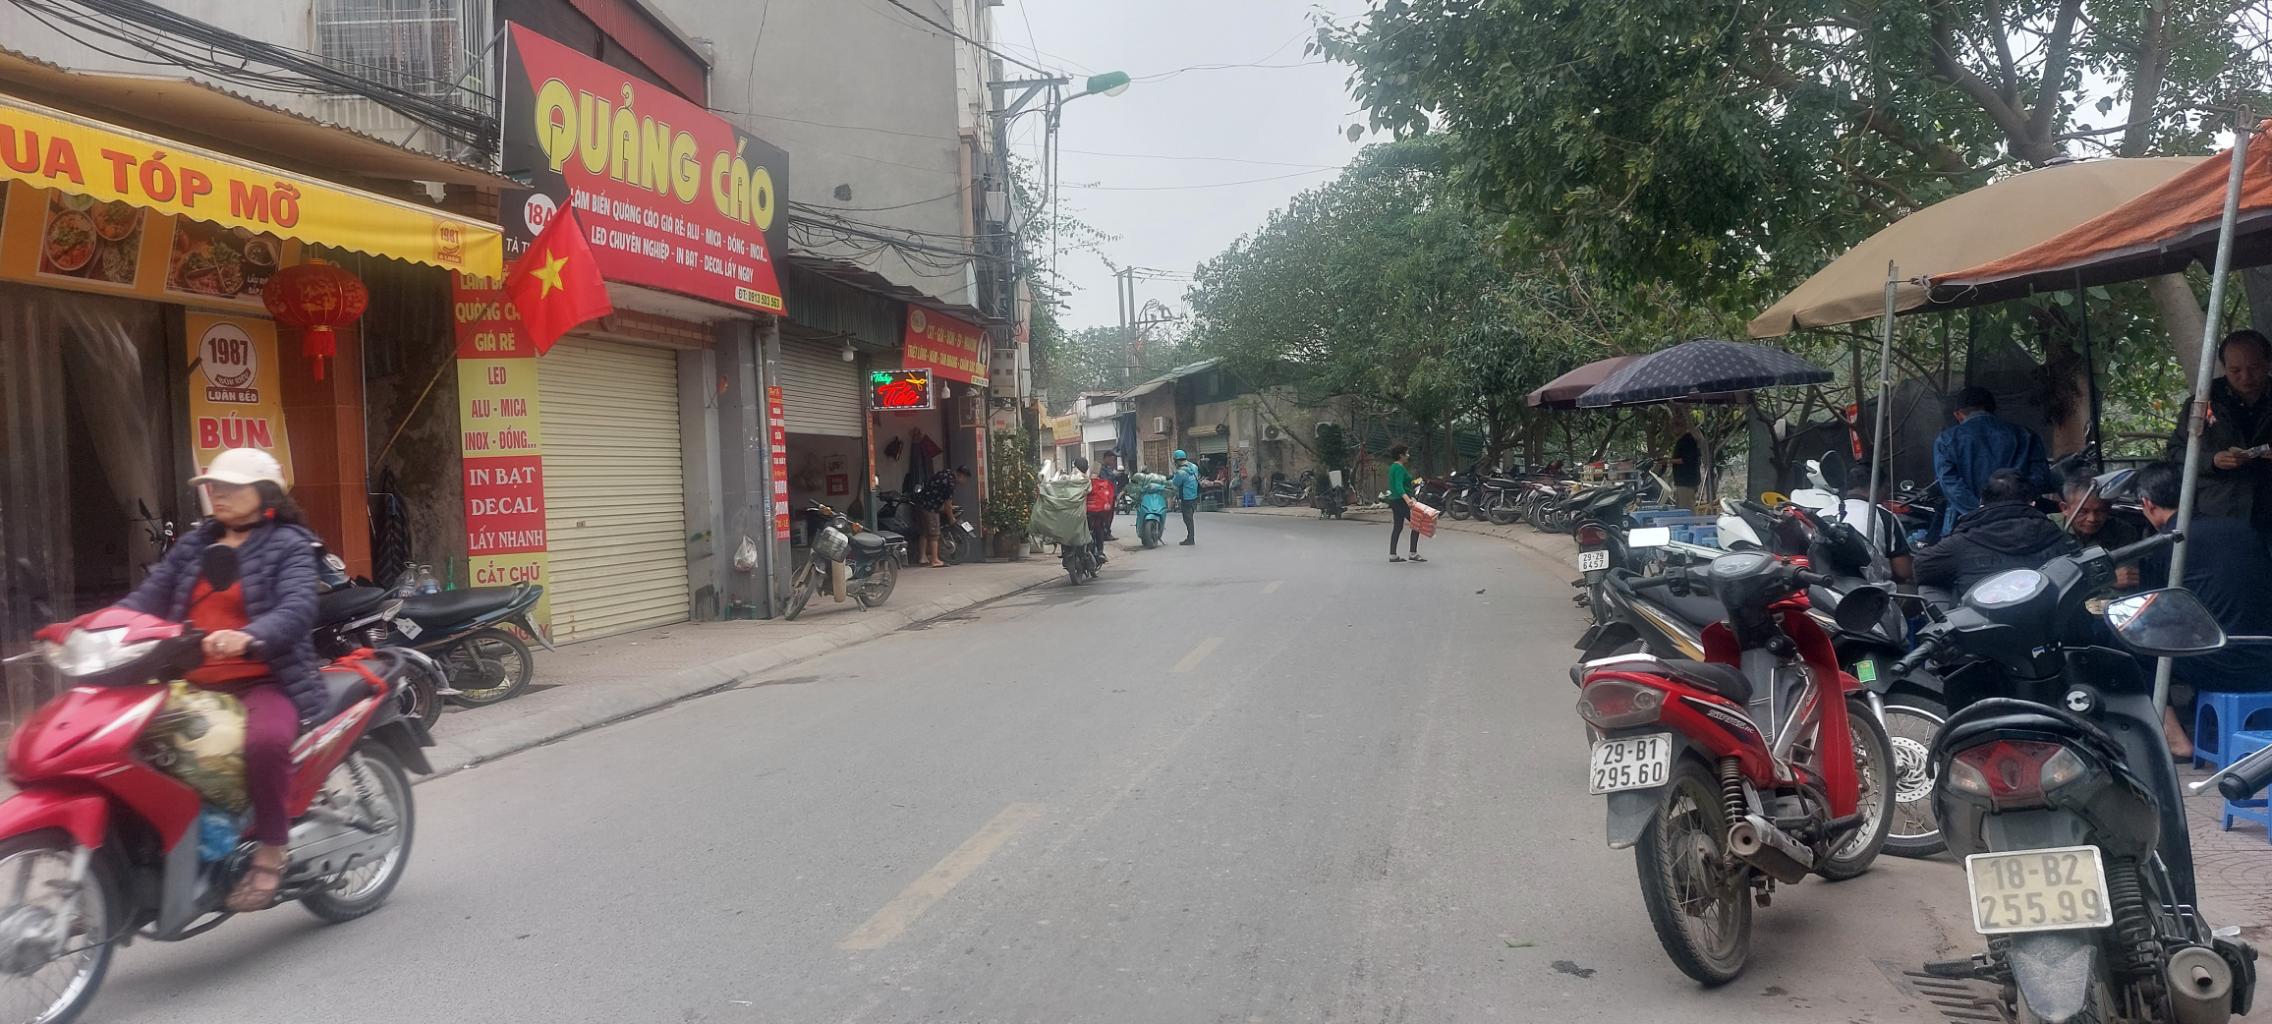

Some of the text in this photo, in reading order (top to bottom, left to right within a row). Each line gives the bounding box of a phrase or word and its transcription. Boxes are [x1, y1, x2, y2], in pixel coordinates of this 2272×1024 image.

[535, 77, 774, 231] QUẢNG CÁO
[0, 123, 301, 229] UA TÓP MỠ
[570, 185, 589, 211] LÀM
[592, 189, 610, 216] BIỂN
[612, 198, 641, 225] QUẢNG
[643, 206, 659, 229] CÁO
[661, 213, 673, 233] GIÁ
[687, 222, 700, 240] ALU
[705, 228, 721, 248] MICA
[591, 225, 754, 283] LED CHUYÊN NGHIỆP IN BẠT DECAL LẤY NGAY
[455, 297, 500, 323] QUẢNG
[208, 337, 248, 366] 1987
[475, 327, 515, 351] GIÁ RẺ
[488, 366, 507, 385] LED
[471, 398, 528, 418] ALU MICA
[199, 411, 273, 449] BÚN
[464, 431, 490, 450] INOX
[469, 467, 536, 489] IN BẠT
[471, 496, 539, 516] DECAL
[469, 525, 544, 550] LẤY NHANH
[476, 560, 540, 584] CẮT CHỮ
[1603, 739, 1657, 765] 29-B1
[1597, 762, 1662, 789] 295.60
[1990, 854, 2083, 890] 18-B2
[1981, 888, 2100, 927] 255.99
